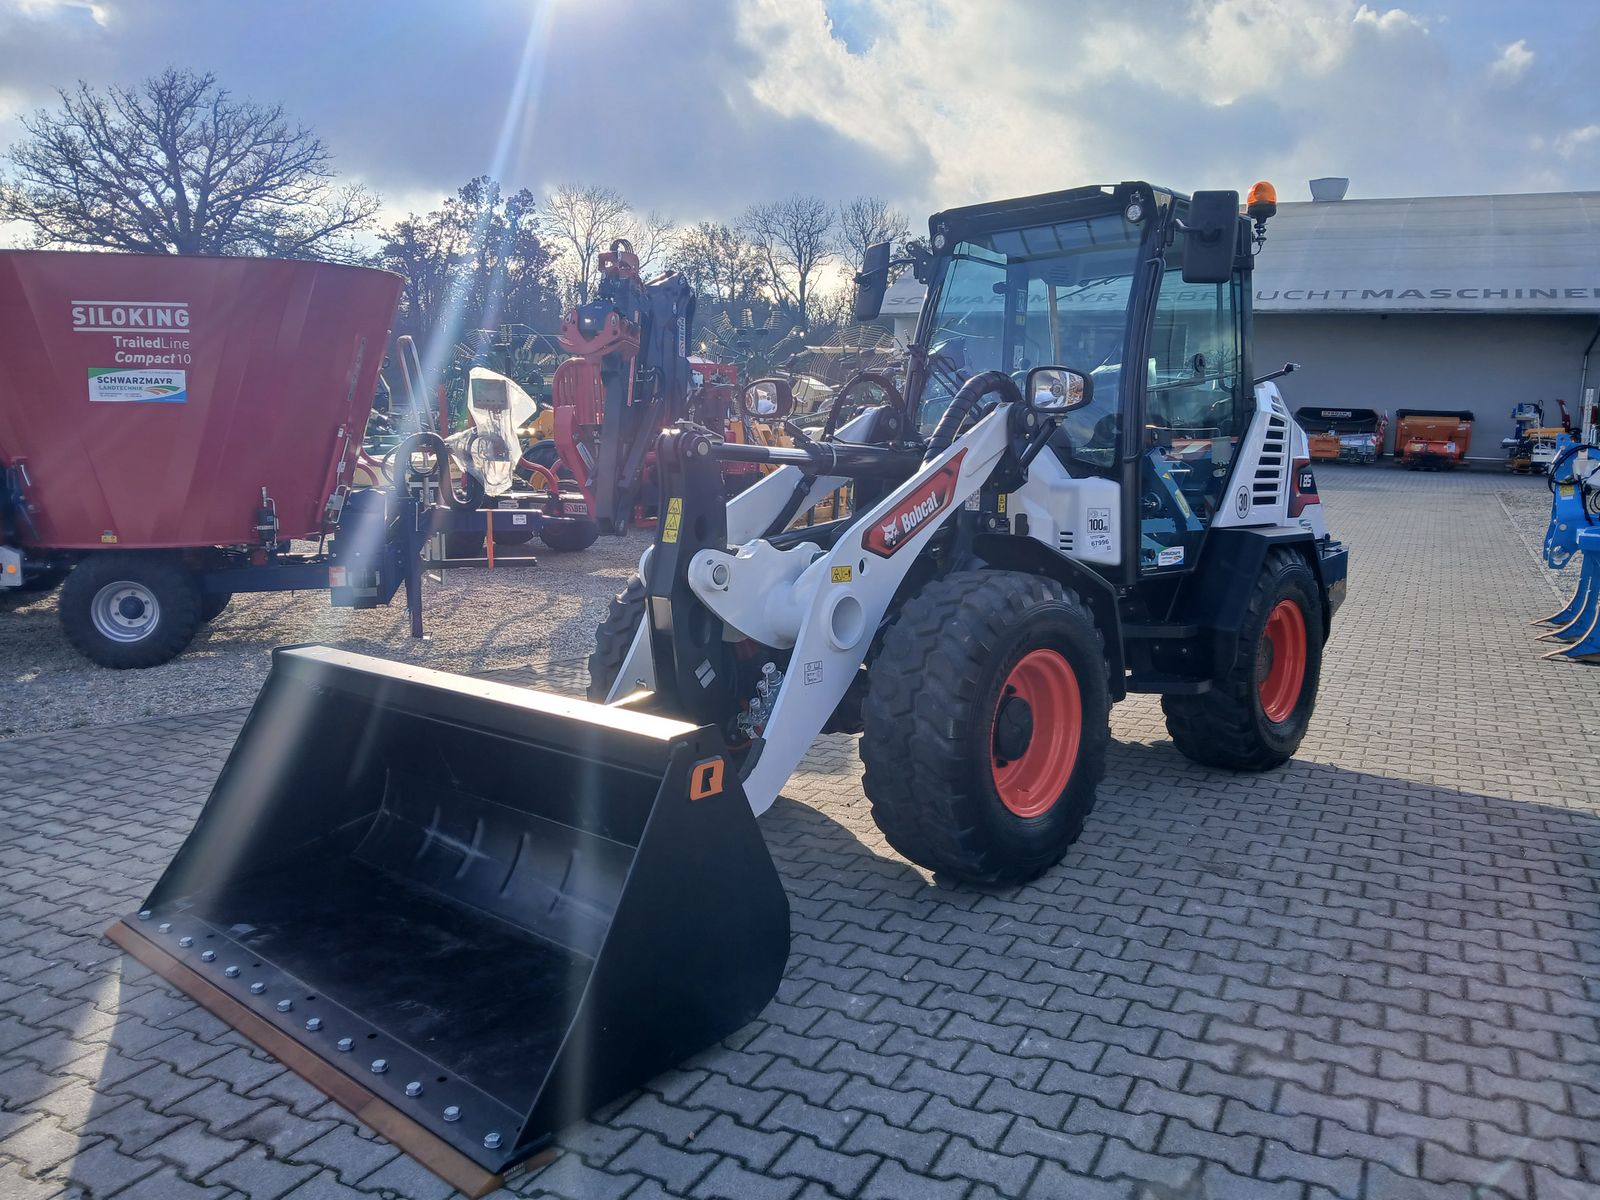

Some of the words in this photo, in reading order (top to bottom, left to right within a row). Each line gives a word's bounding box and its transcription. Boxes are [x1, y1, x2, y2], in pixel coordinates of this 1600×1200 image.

[71, 306, 190, 327] SILOKING
[96, 376, 173, 385] SCHWARZMAYR
[900, 490, 940, 534] Bobcat
[1238, 492, 1249, 512] 30
[1088, 518, 1104, 531] 100
